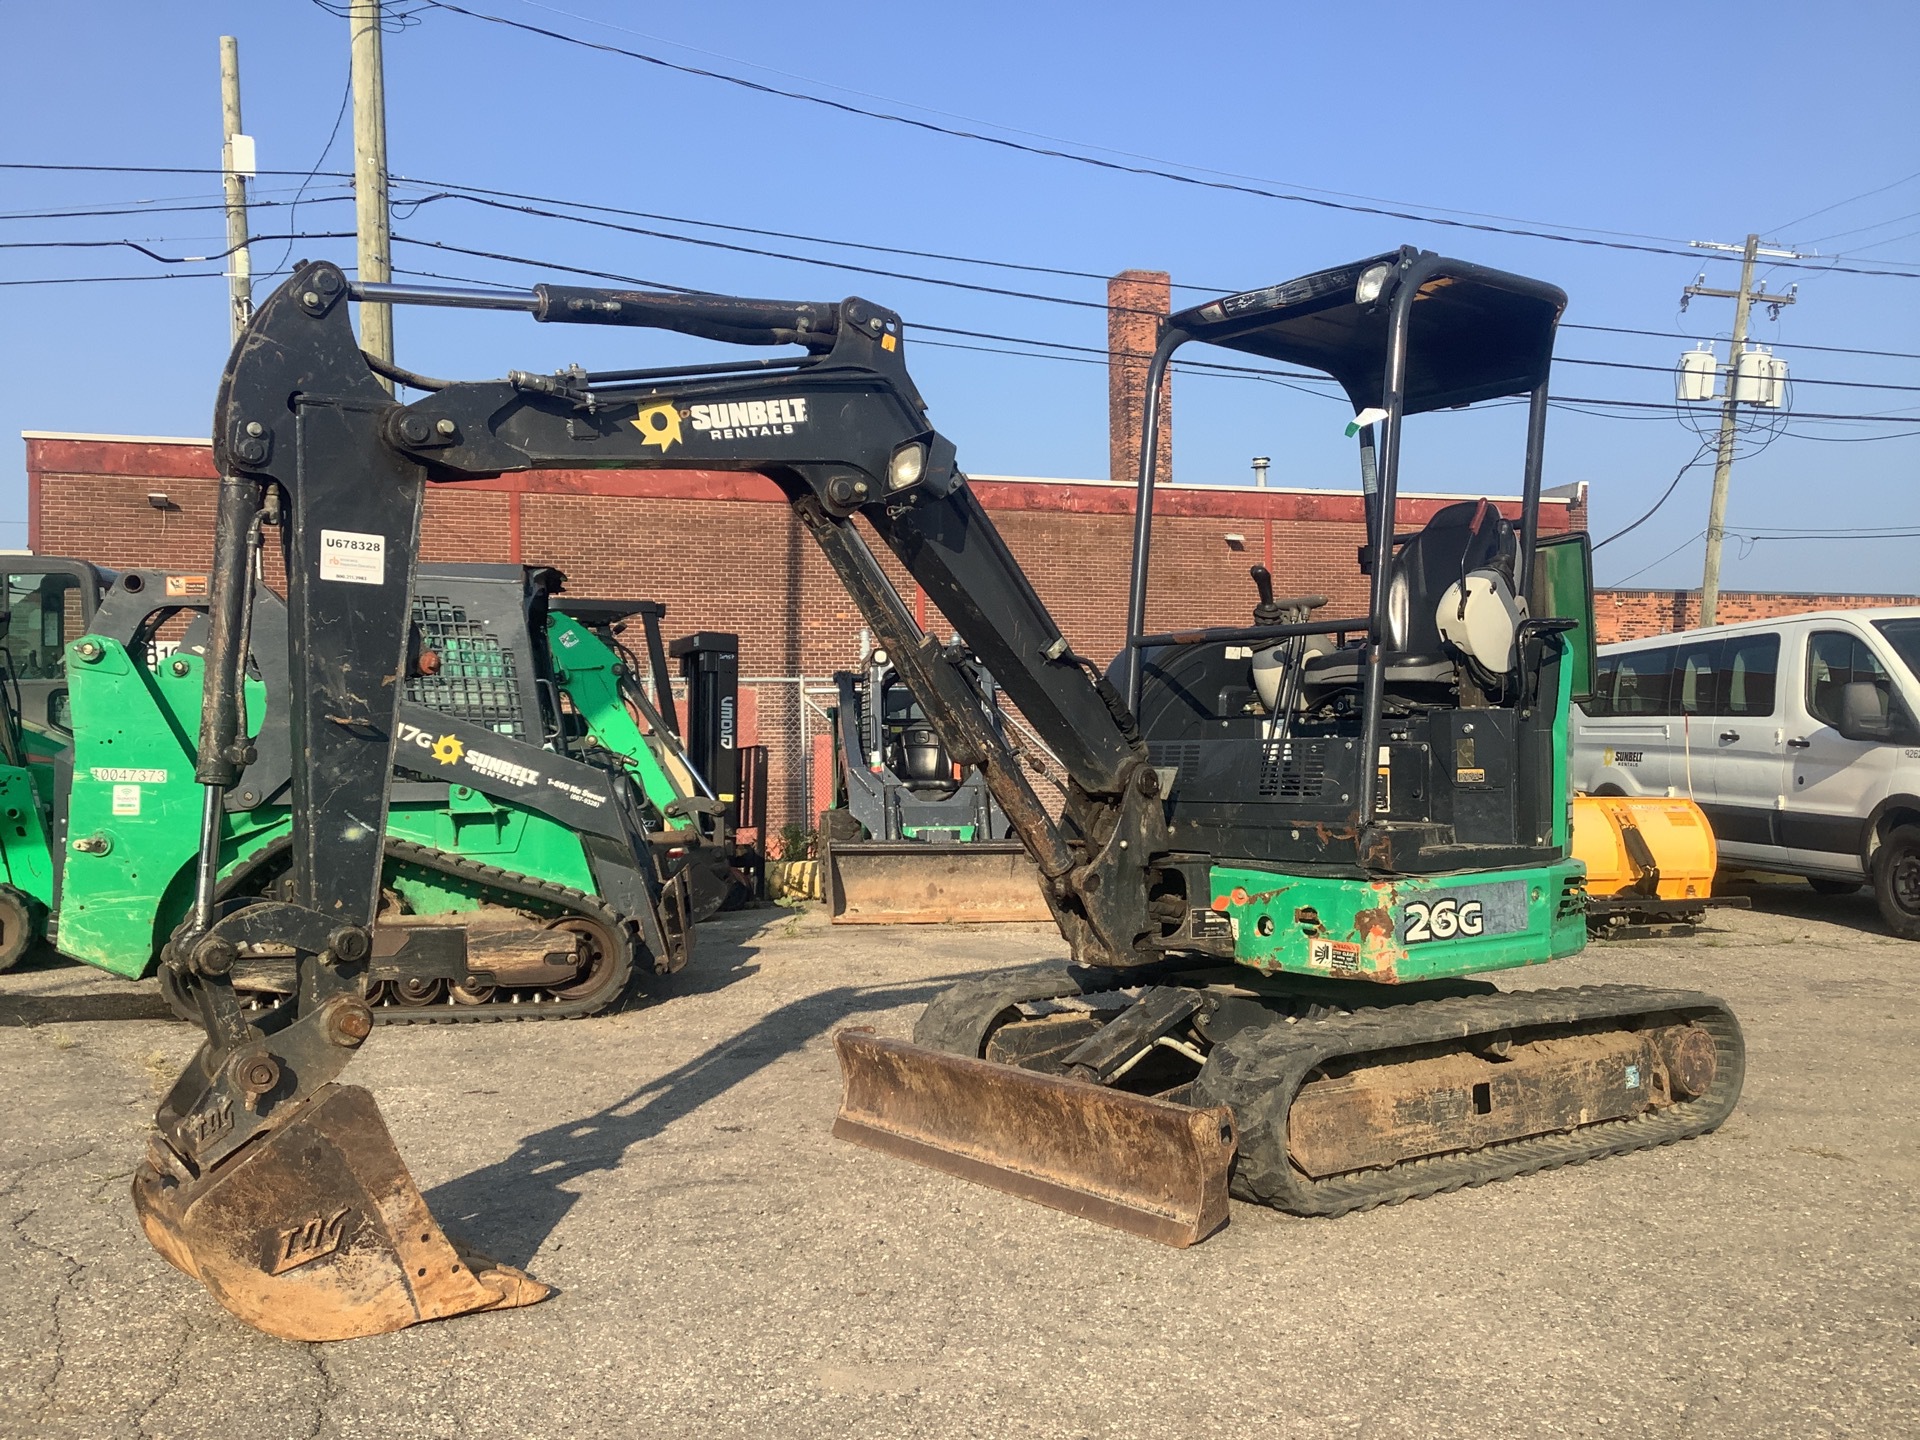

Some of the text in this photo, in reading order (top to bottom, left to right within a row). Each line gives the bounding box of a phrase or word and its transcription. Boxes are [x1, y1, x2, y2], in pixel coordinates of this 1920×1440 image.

[690, 398, 806, 430] SUNBELT
[709, 424, 794, 440] RENTALS
[326, 538, 381, 552] U678328
[464, 749, 540, 783] SUNBELT
[1615, 751, 1643, 762] SUNBELT
[471, 765, 525, 787] RENTALS
[547, 778, 570, 791] 1-800
[569, 785, 582, 795] No
[1404, 899, 1483, 944] 26G
